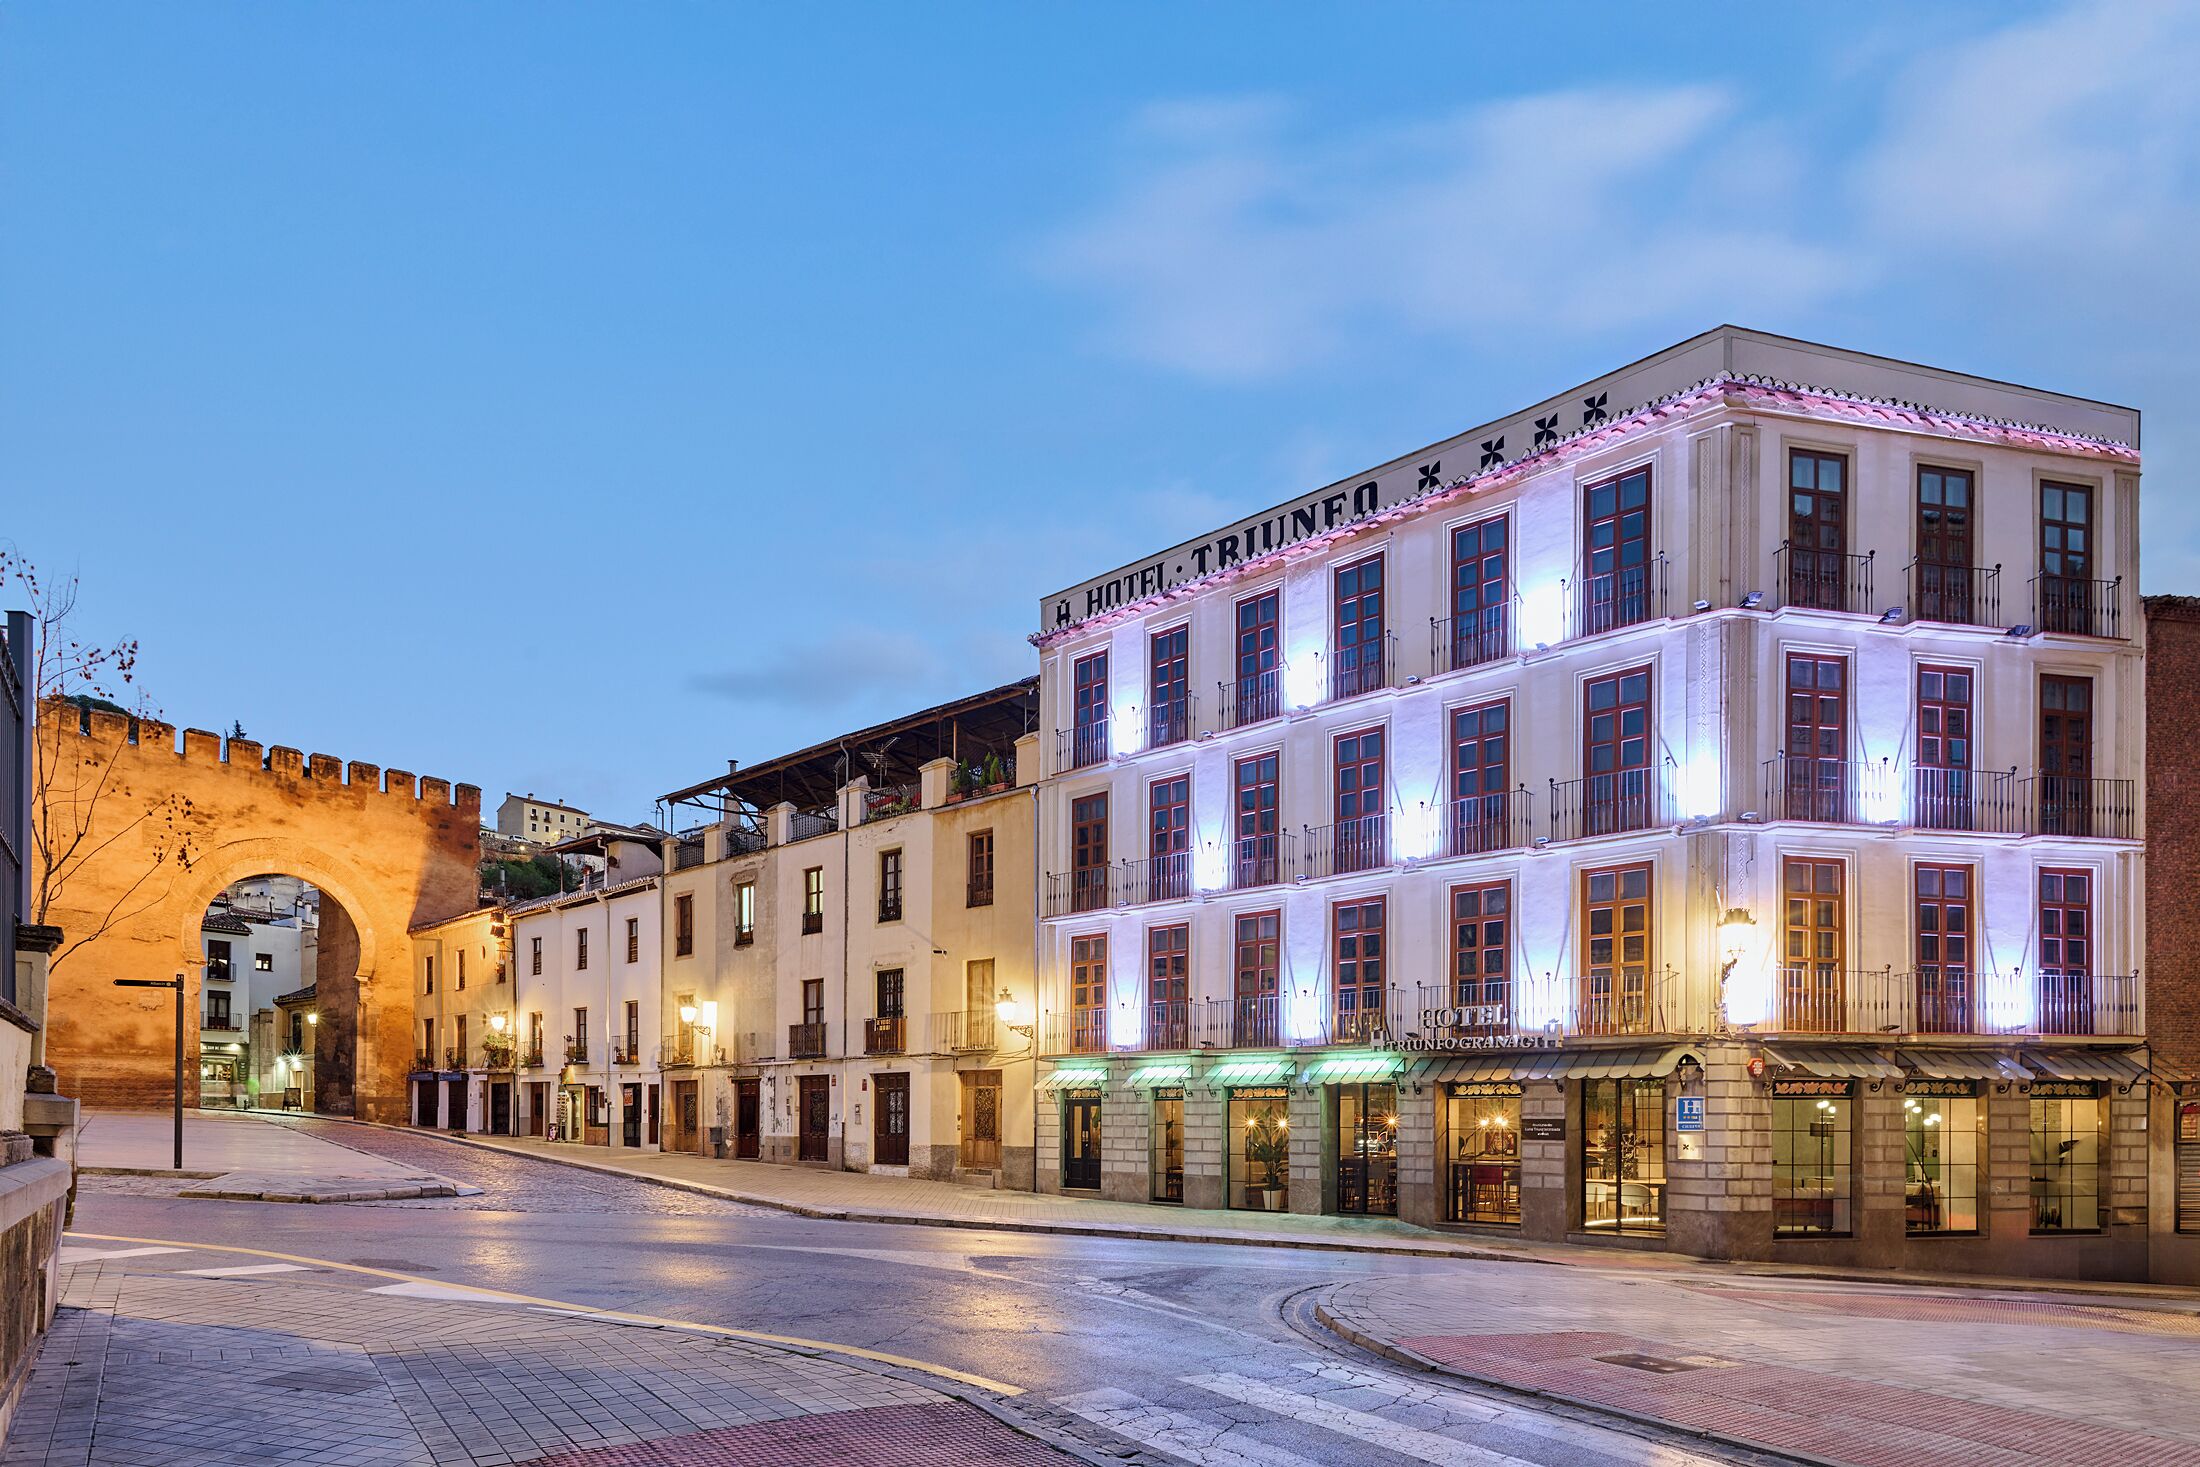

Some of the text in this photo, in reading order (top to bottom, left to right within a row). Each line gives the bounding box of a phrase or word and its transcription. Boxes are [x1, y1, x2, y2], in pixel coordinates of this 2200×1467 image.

[1086, 562, 1172, 617] HOTEL
[1191, 481, 1379, 576] TRIUNFO
[1419, 1004, 1508, 1029] HOTEL
[1386, 1036, 1457, 1052] TRIUNFO
